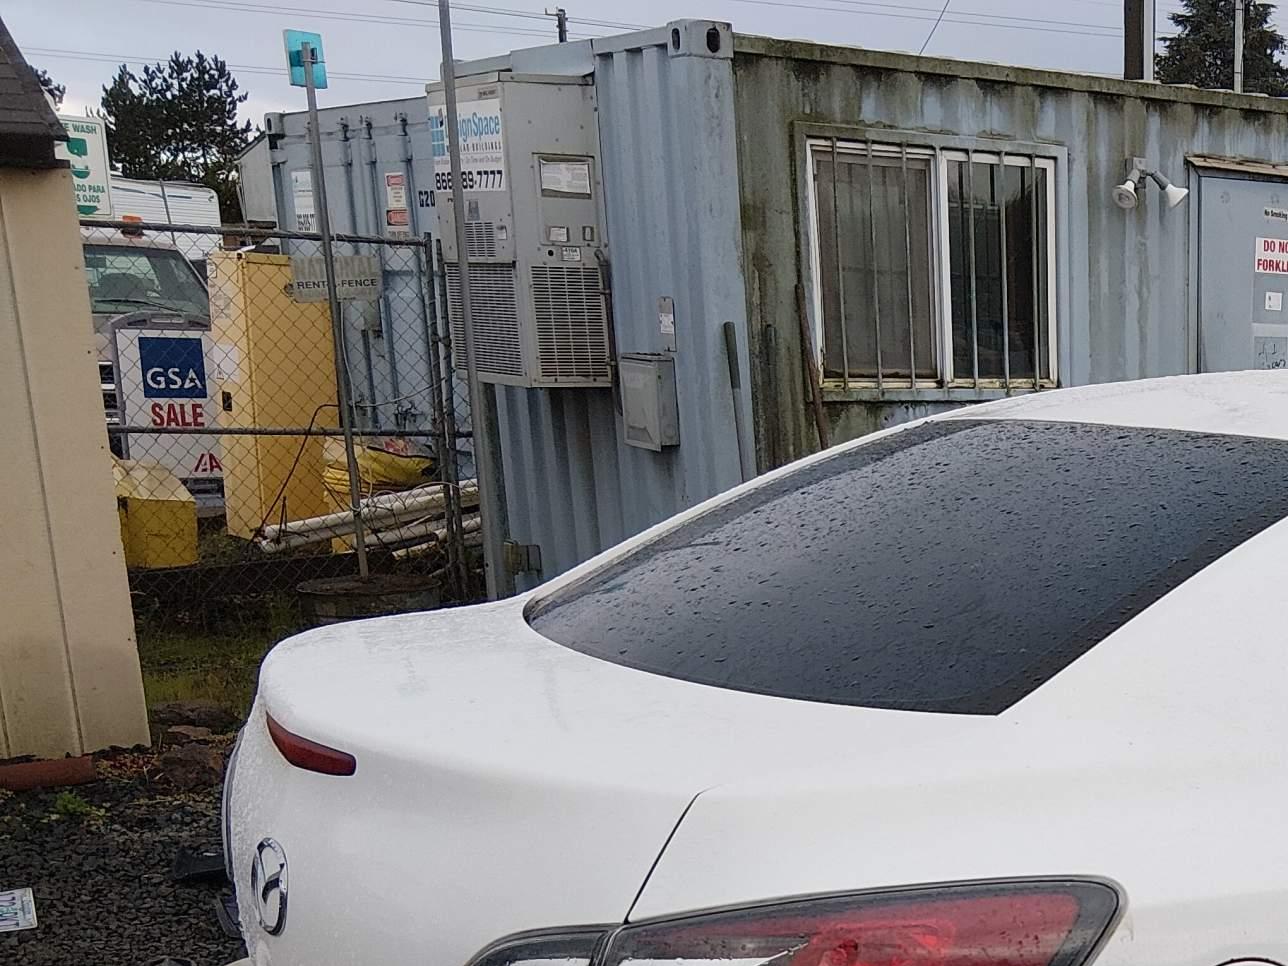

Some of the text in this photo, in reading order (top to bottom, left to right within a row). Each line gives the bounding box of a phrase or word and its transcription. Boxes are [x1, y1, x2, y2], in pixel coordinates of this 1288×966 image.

[72, 123, 97, 134] WASH
[1263, 239, 1276, 253] DO
[146, 367, 203, 389] GSA
[151, 402, 206, 428] SALE
